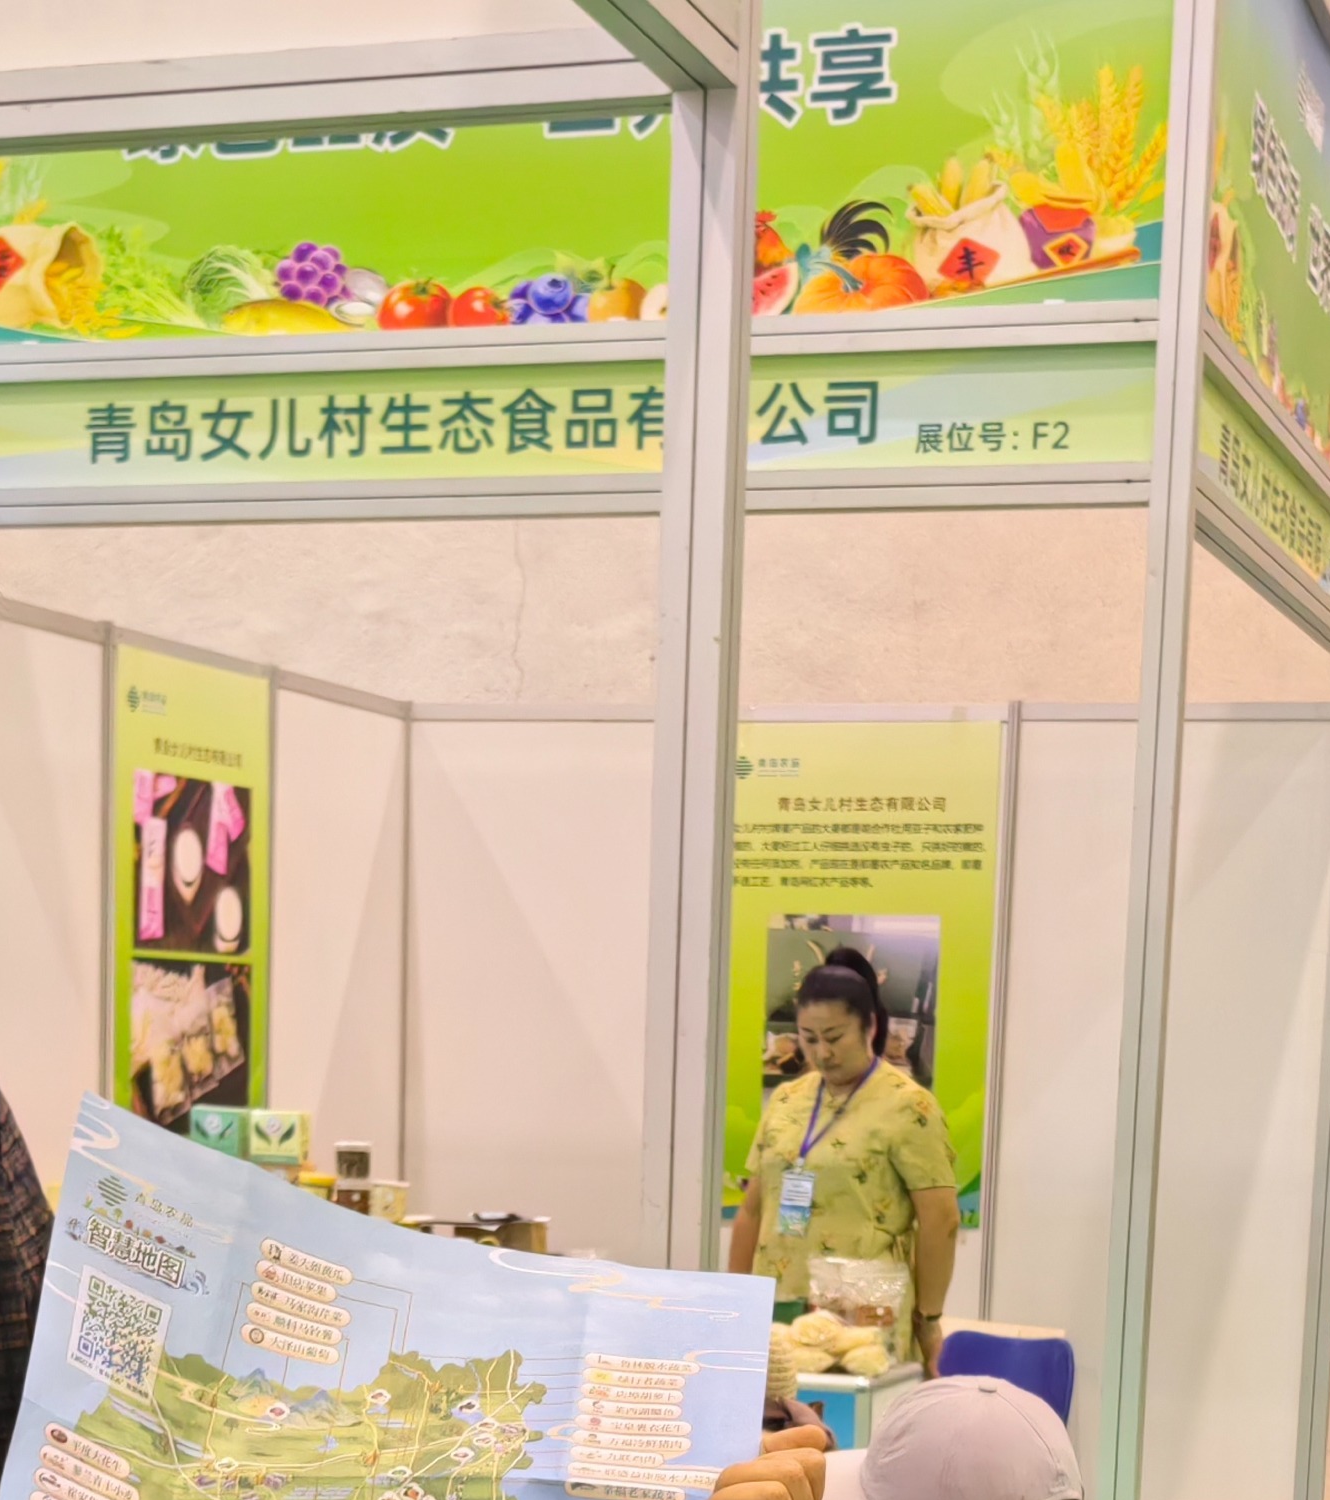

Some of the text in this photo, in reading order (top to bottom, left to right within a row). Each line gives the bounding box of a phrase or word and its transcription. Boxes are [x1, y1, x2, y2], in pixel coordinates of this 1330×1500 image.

[1032, 422, 1070, 450] F2
[88, 1215, 187, 1289] 智慧地图
